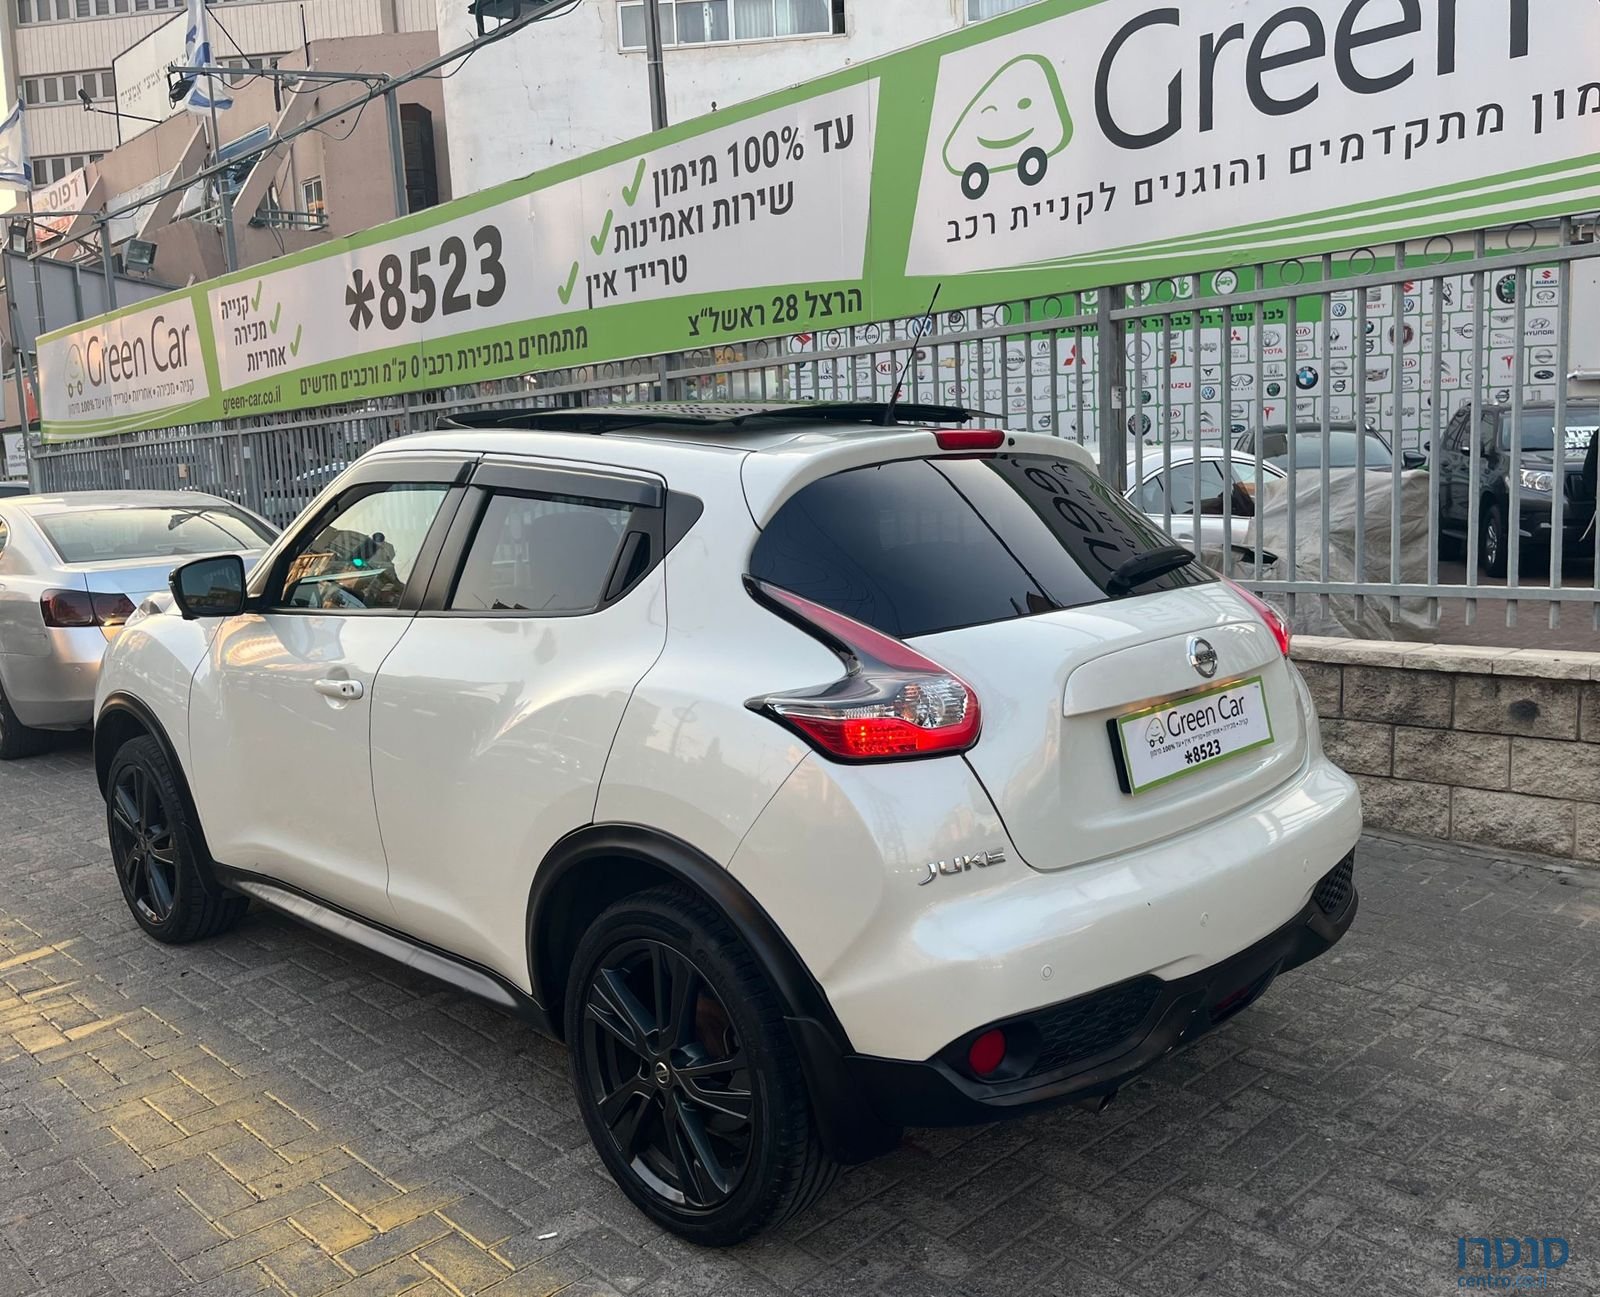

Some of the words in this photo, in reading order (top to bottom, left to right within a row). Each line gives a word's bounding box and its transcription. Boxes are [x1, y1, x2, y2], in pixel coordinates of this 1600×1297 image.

[814, 114, 854, 153] עד
[1290, 103, 1504, 174] מתקדמים
[727, 126, 804, 177] 100%
[653, 155, 718, 208] מימון
[1135, 153, 1266, 206] והוגנים
[712, 181, 794, 230] שירות
[1010, 181, 1116, 230] לקניית
[614, 204, 704, 254] ואמינות
[947, 212, 996, 243] רכב
[586, 269, 618, 309] אין
[625, 254, 687, 292] טרייד
[221, 295, 249, 320] קנייה
[772, 294, 798, 324] 28
[805, 289, 862, 318] הרצל
[234, 321, 267, 346] מכירה
[519, 326, 588, 359] מתמחים
[87, 336, 147, 387] Green
[151, 315, 190, 372] Car
[247, 346, 287, 372] אחריות
[411, 356, 420, 378] 0
[423, 352, 453, 377] רכבי
[458, 342, 513, 371] במכירת
[156, 383, 176, 398] מכירה
[300, 375, 337, 396] חדשים
[341, 367, 378, 389] ורכבים
[223, 385, 281, 414] green-car.co.il
[1167, 706, 1217, 737] Green
[1218, 695, 1244, 720] Car
[918, 847, 1006, 886] JUKE
